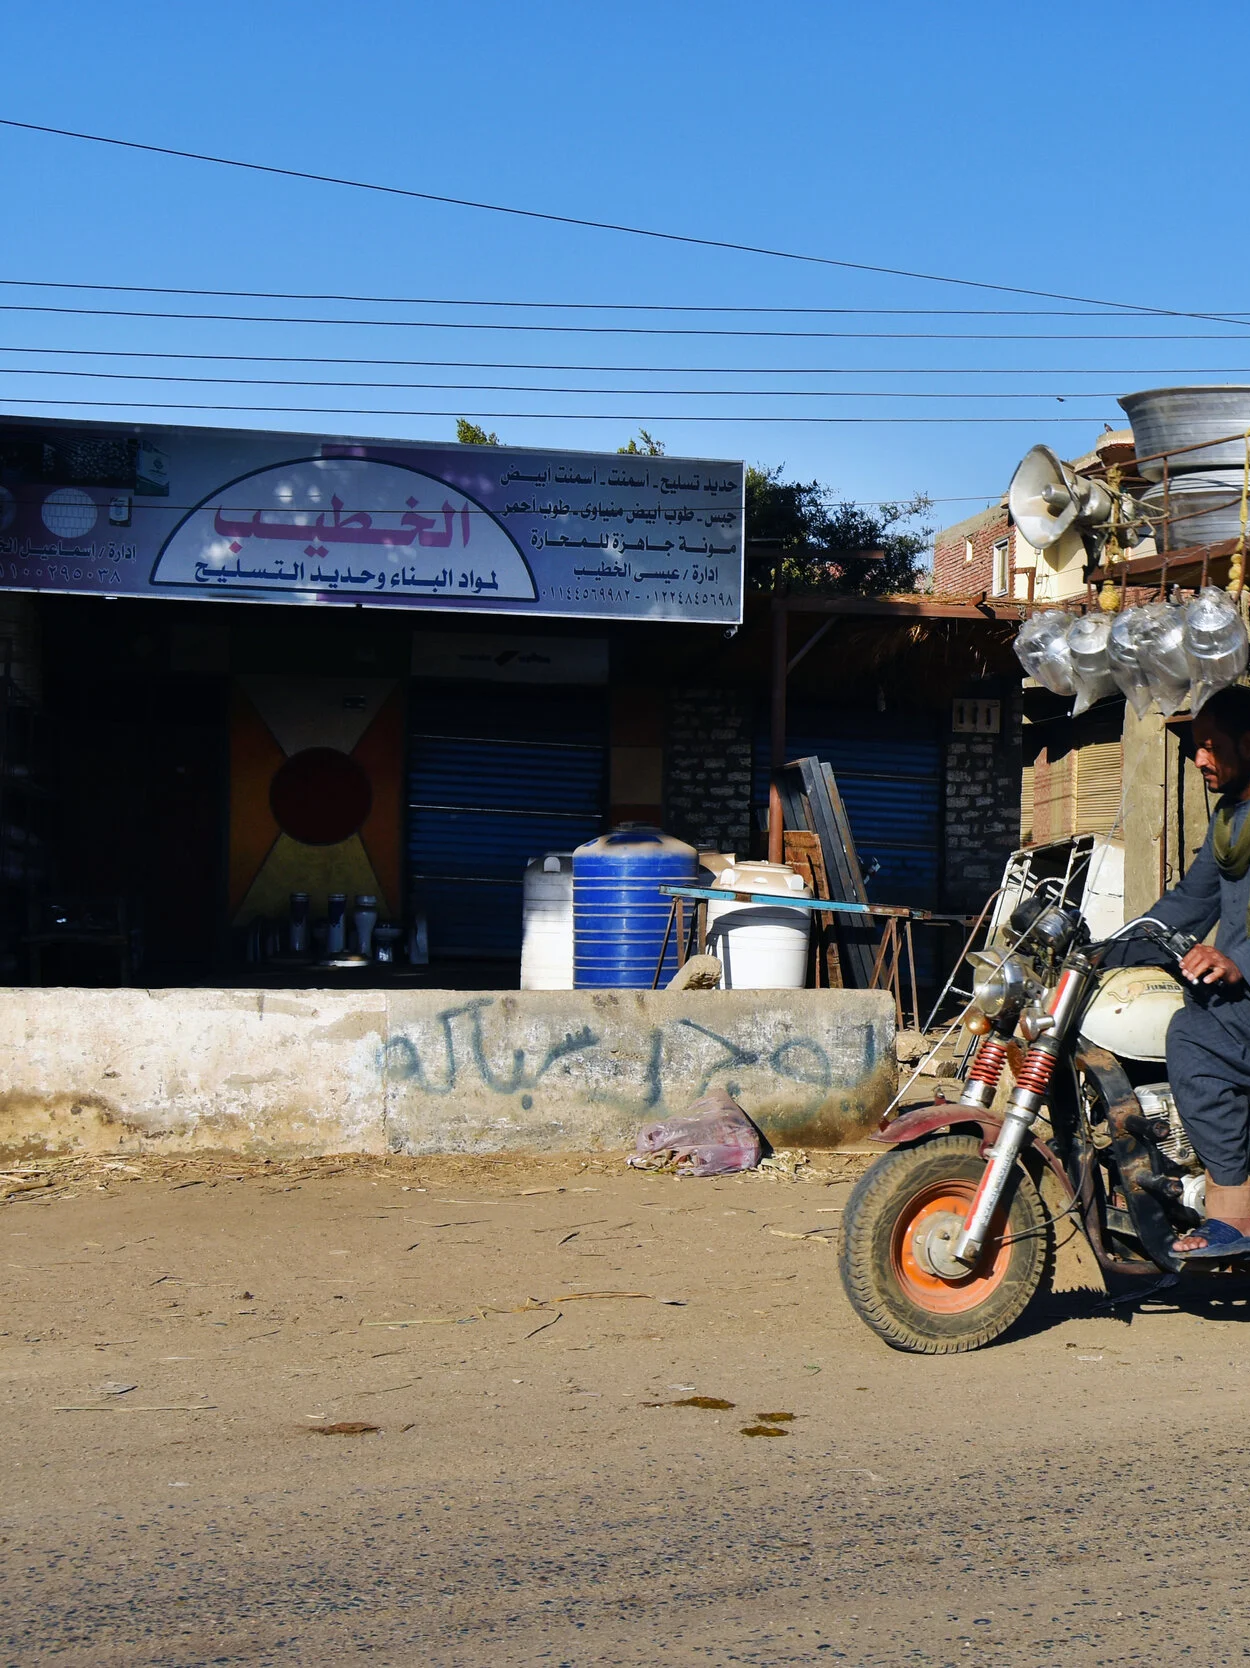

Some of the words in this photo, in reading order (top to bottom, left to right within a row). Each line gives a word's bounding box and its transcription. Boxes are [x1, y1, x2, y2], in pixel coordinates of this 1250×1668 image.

[500, 463, 551, 487] أبيض
[554, 465, 597, 485] أسمنت
[608, 467, 650, 486] أسمنت
[660, 474, 700, 494] تسليح
[703, 475, 738, 496] حديد
[501, 495, 536, 517] أحمر
[539, 499, 571, 520] طوب
[626, 502, 661, 524] أبيض
[664, 507, 695, 526] طوب
[214, 493, 470, 558] الخطيب
[704, 509, 737, 527] جبس
[19, 537, 96, 562] إسماعيل
[530, 527, 609, 550] للمحارة
[613, 531, 675, 556] جاهزة
[678, 534, 737, 559] مونة
[109, 541, 137, 564] إدارة
[194, 559, 305, 584] التسليح
[309, 565, 386, 589] وحديد
[390, 566, 453, 593] البناء
[573, 560, 632, 580] الخطيب
[633, 566, 680, 585] عيسى
[691, 563, 719, 585] إدارة
[458, 570, 499, 594] لمواد
